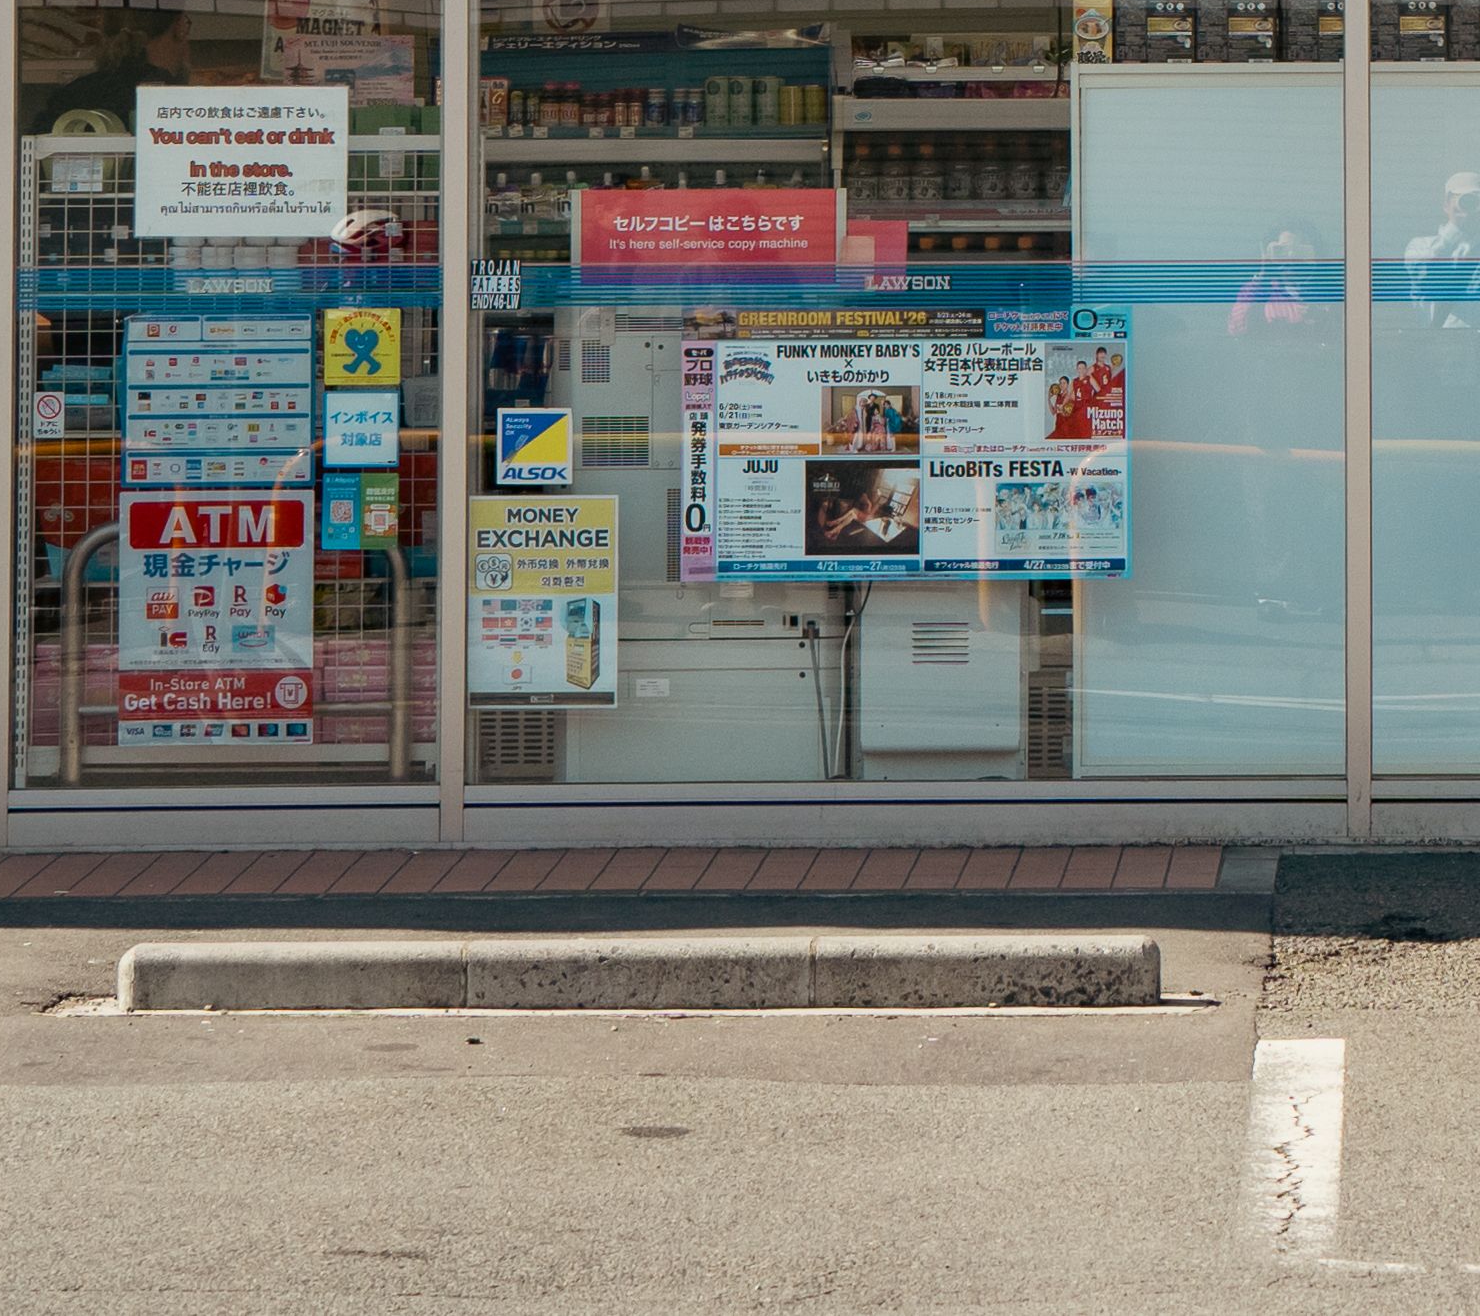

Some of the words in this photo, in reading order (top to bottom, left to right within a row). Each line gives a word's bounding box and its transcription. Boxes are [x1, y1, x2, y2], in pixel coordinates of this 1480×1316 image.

[296, 17, 365, 36] MAGNET
[157, 106, 326, 121] 店内での飲食はご遠慮下さい。
[149, 128, 183, 145] You
[186, 128, 232, 145] can't
[235, 130, 264, 145] eat
[266, 132, 286, 145] or
[289, 127, 335, 145] drink
[190, 161, 206, 178] in
[209, 161, 239, 178] the
[242, 162, 293, 178] store.
[181, 181, 295, 197] 不能在店裡飲食。
[613, 216, 804, 232] セルフコピーはこちらです
[609, 238, 626, 250] It's
[630, 238, 656, 249] here
[659, 237, 725, 249] self-service
[728, 240, 756, 251] copy
[759, 237, 809, 249] machine
[471, 259, 520, 275] TROJAN
[187, 278, 272, 294] LAWSON
[865, 275, 951, 290] LAWSON
[471, 294, 520, 309] ENDY46-LW
[739, 311, 831, 326] GREENROOM
[777, 345, 817, 358] FUNKY
[820, 344, 871, 358] MONKEY
[931, 344, 962, 356] 2026
[966, 343, 1037, 355] バレーボール
[685, 360, 712, 372] プロ
[924, 358, 1043, 372] 女子日本代表紅白試合
[684, 374, 713, 386] 野球
[807, 370, 890, 383] いきものがかり
[949, 373, 1019, 386] ミズノマッチ
[330, 411, 394, 425] インボイス
[1087, 406, 1124, 419] Mizuno
[924, 426, 985, 434] 千葉ポートアリーナ
[1092, 419, 1124, 430] Match
[340, 432, 382, 447] 対象店
[691, 422, 707, 502] 発券手数料
[742, 460, 779, 474] JUJU
[930, 461, 1004, 478] LicoBiTs
[1009, 460, 1064, 478] FESTA
[502, 466, 568, 481] ALSOK
[507, 508, 578, 524] MONEY
[685, 503, 711, 532] 0円
[160, 505, 277, 544] ATM
[476, 529, 609, 549] EXCHANGE
[143, 551, 290, 578] 現金チャージ
[516, 558, 560, 570] 外币兑换
[541, 576, 585, 587] 외화환전
[152, 604, 173, 616] PAY
[188, 609, 220, 619] PayPay
[230, 607, 251, 618] Pay
[265, 606, 286, 618] Pay
[203, 642, 220, 653] Edy
[150, 677, 209, 690] In-Store
[215, 677, 246, 689] ATM
[124, 695, 157, 712] Get
[163, 693, 213, 711] Cash
[218, 692, 271, 709] Here!
[126, 728, 145, 736] VISA
